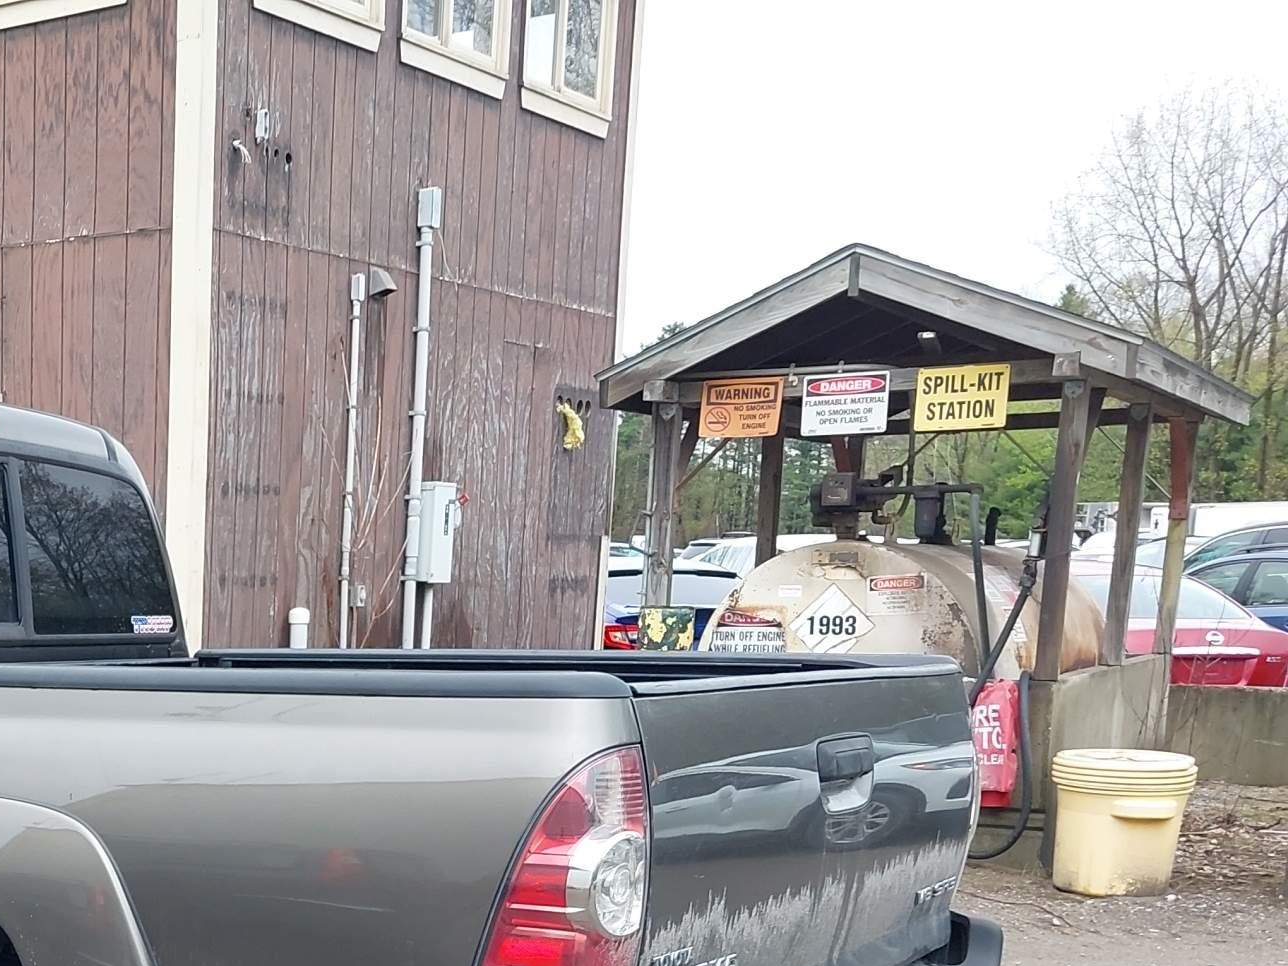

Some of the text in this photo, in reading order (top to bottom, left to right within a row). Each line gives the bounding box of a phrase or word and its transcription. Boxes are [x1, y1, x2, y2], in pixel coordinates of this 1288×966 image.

[820, 380, 872, 392] DANGER
[922, 371, 1004, 395] SPILL-KIT
[715, 387, 770, 401] WARNING
[805, 398, 848, 407] FLAMMABLE
[745, 404, 777, 412] SMOKING
[828, 408, 861, 416] SMOKING
[926, 399, 995, 421] STATION
[840, 416, 869, 424] FLAMES
[741, 422, 767, 430] ENGINE
[877, 579, 916, 589] DANGER
[806, 615, 857, 636] 1993
[714, 631, 786, 642] TURN OFF ENGINE
